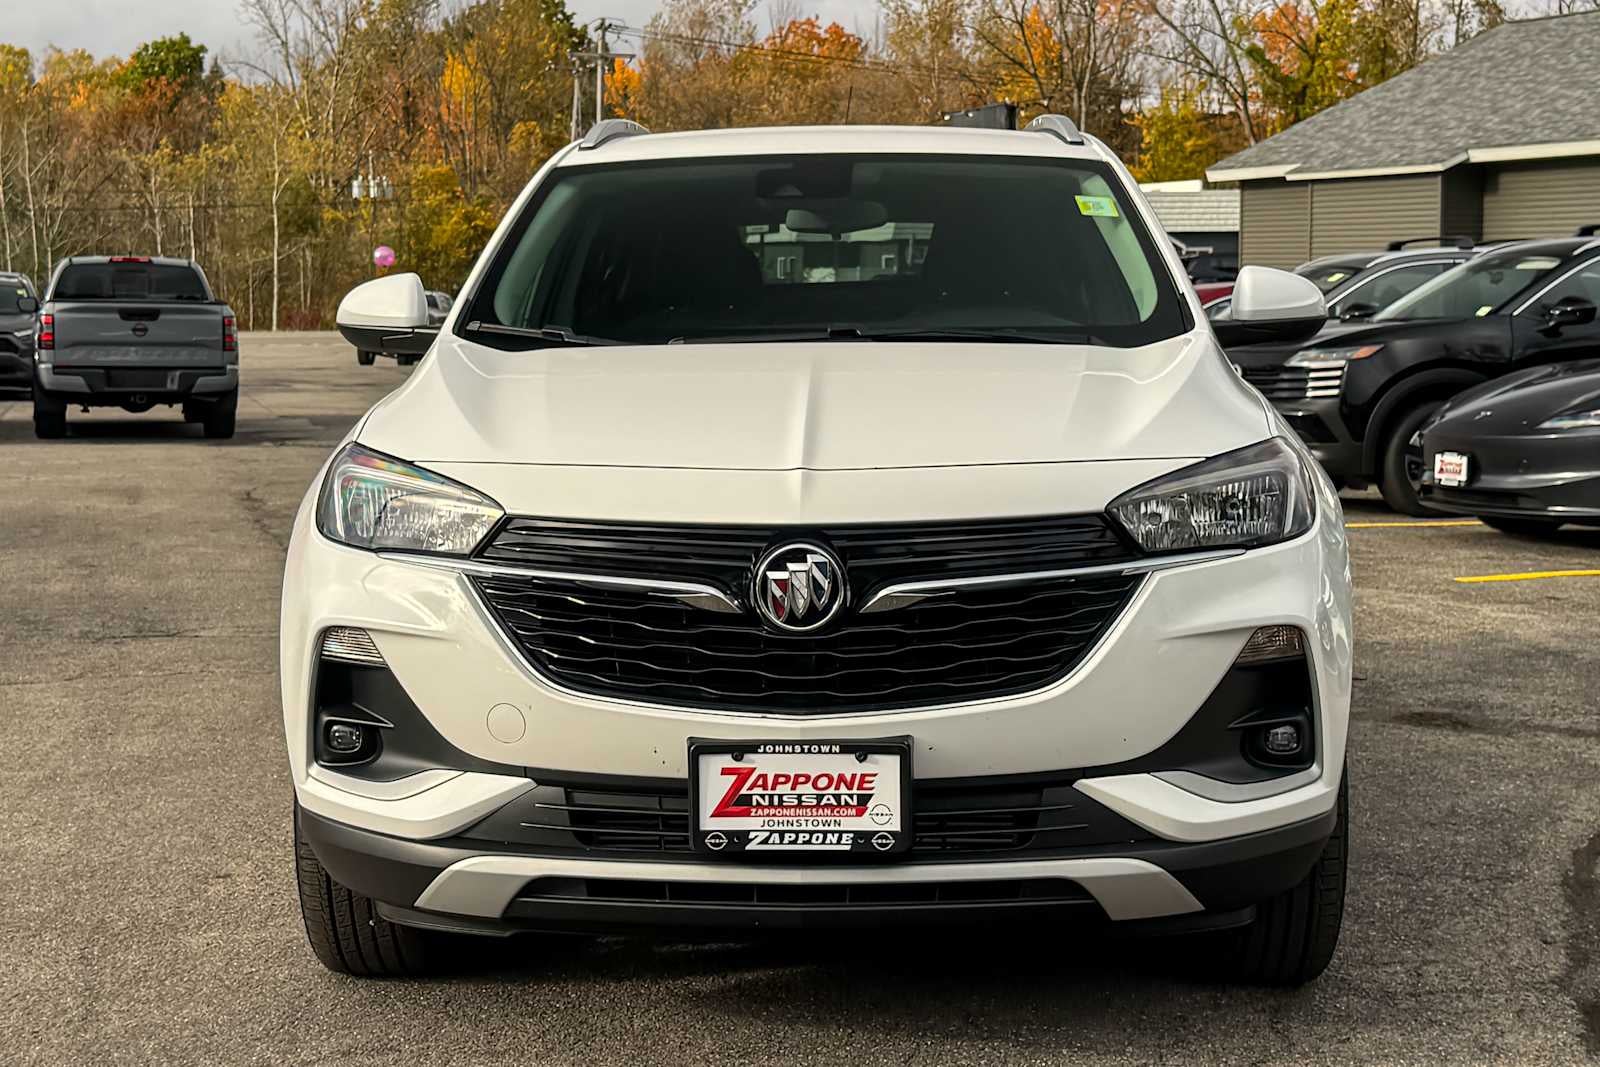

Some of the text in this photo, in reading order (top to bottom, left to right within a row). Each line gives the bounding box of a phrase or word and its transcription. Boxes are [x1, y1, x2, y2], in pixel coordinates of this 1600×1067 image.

[757, 744, 841, 754] JOHNSTOWN
[710, 767, 879, 818] ZAPPONE
[751, 793, 859, 806] NISSAN
[750, 807, 857, 817] ZAPPONENISSAN.COM
[760, 819, 843, 828] JOHNSTOWN
[744, 831, 855, 851] ZAPPONE
